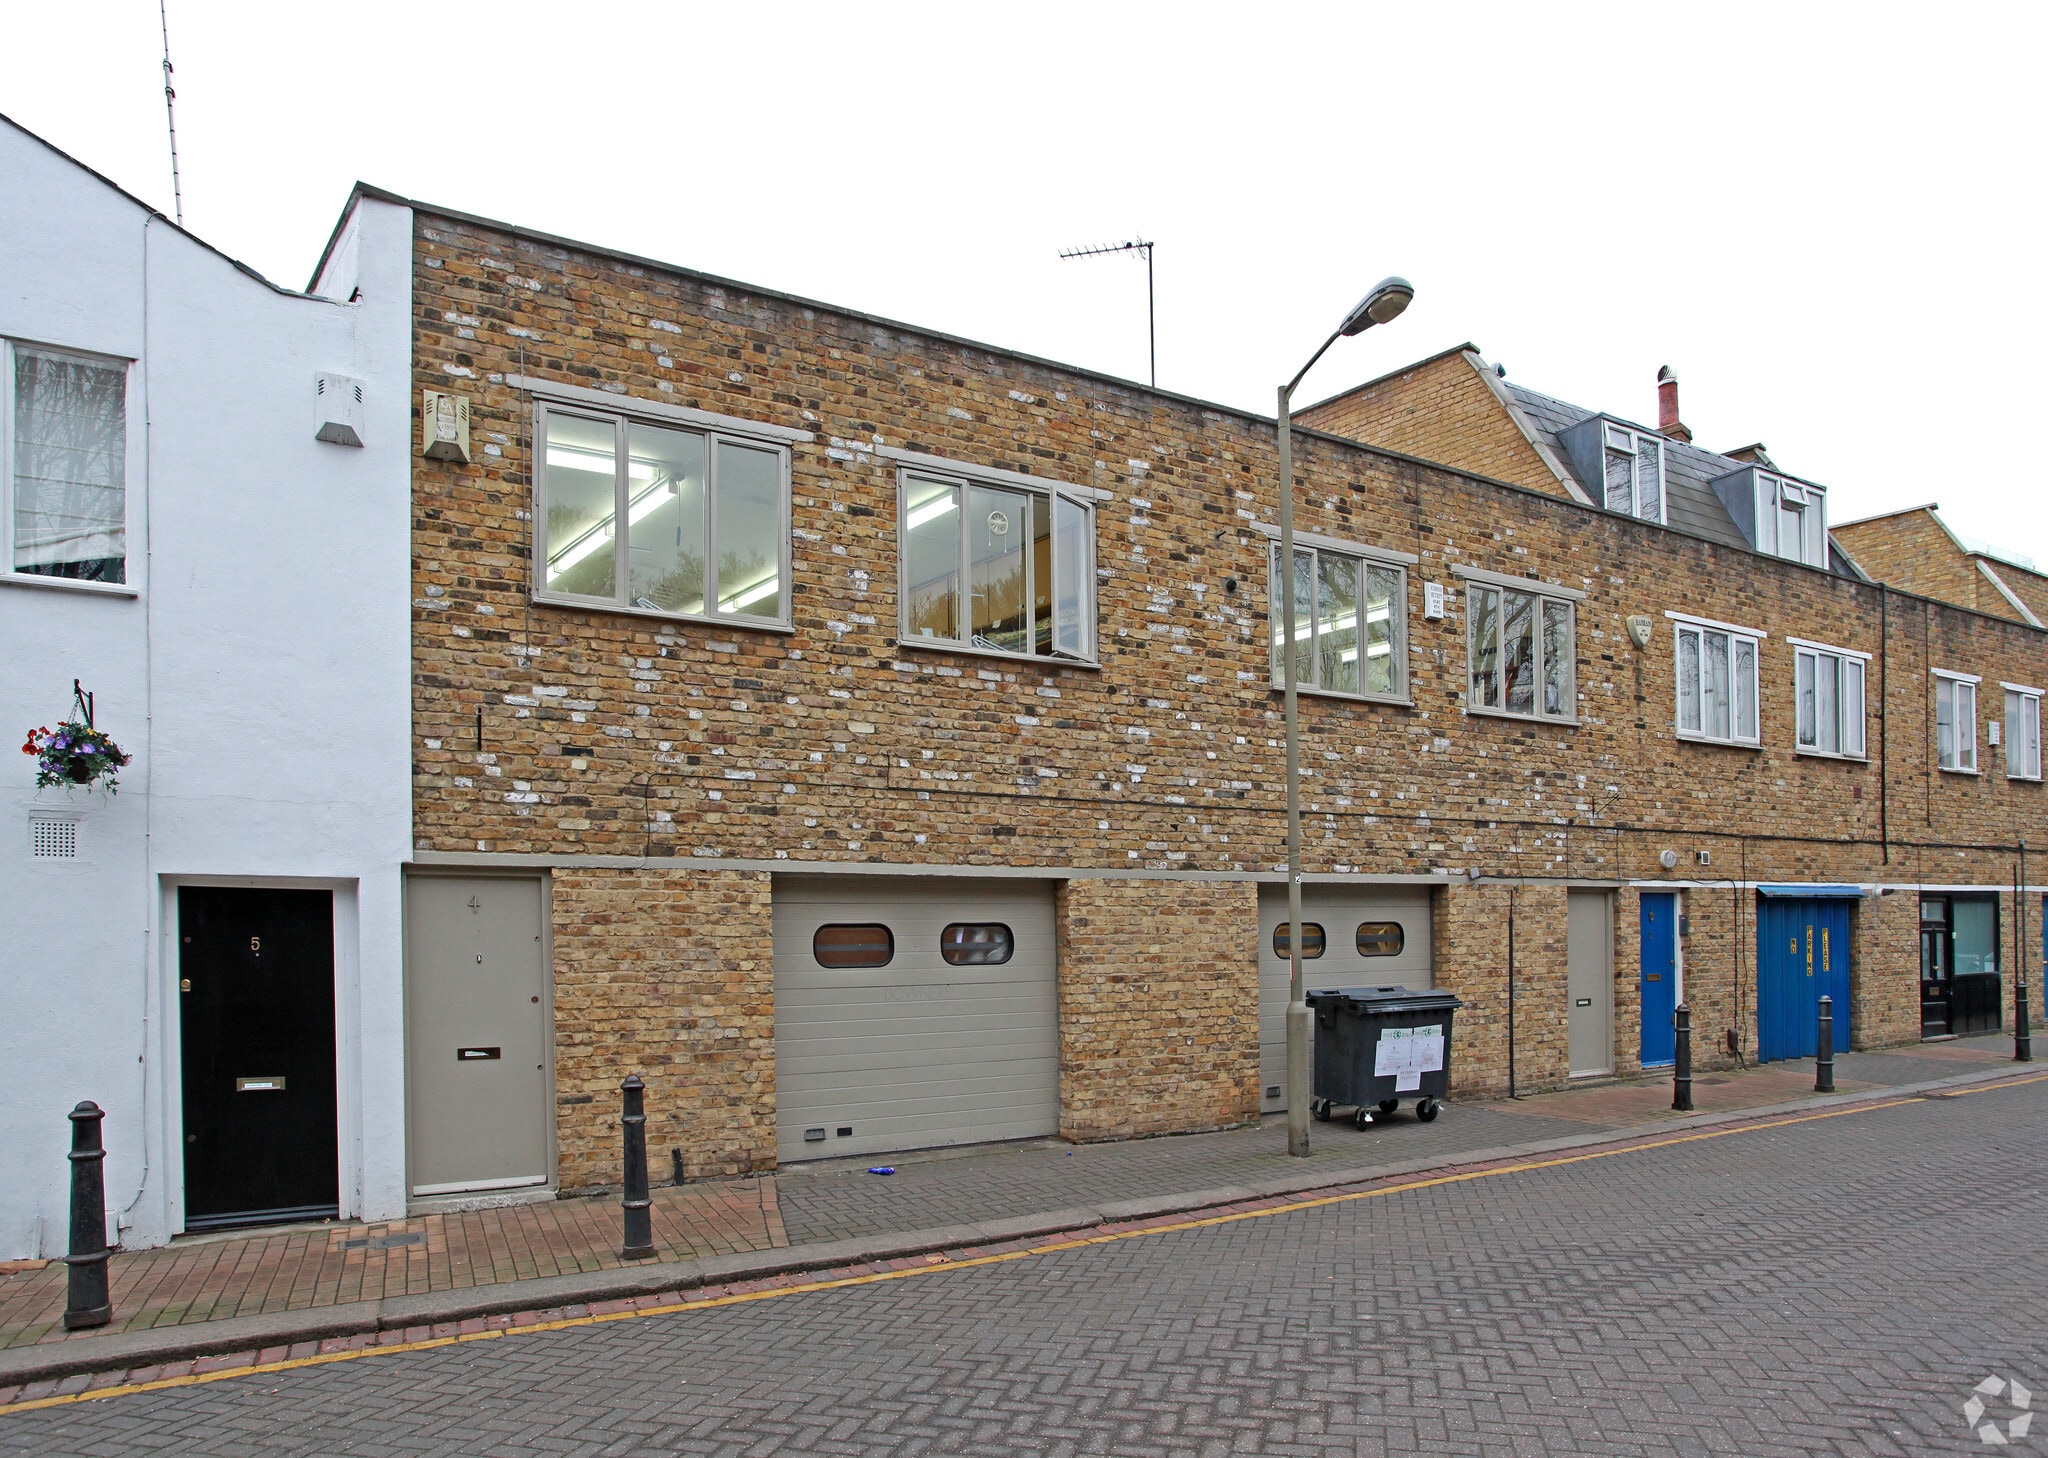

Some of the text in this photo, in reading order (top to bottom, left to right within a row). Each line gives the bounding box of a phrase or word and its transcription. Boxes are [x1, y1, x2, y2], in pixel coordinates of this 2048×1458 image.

[467, 895, 481, 913] 4
[250, 936, 260, 951] 5
[1791, 938, 1797, 954] NO
[884, 985, 952, 1001] DOWNERS
